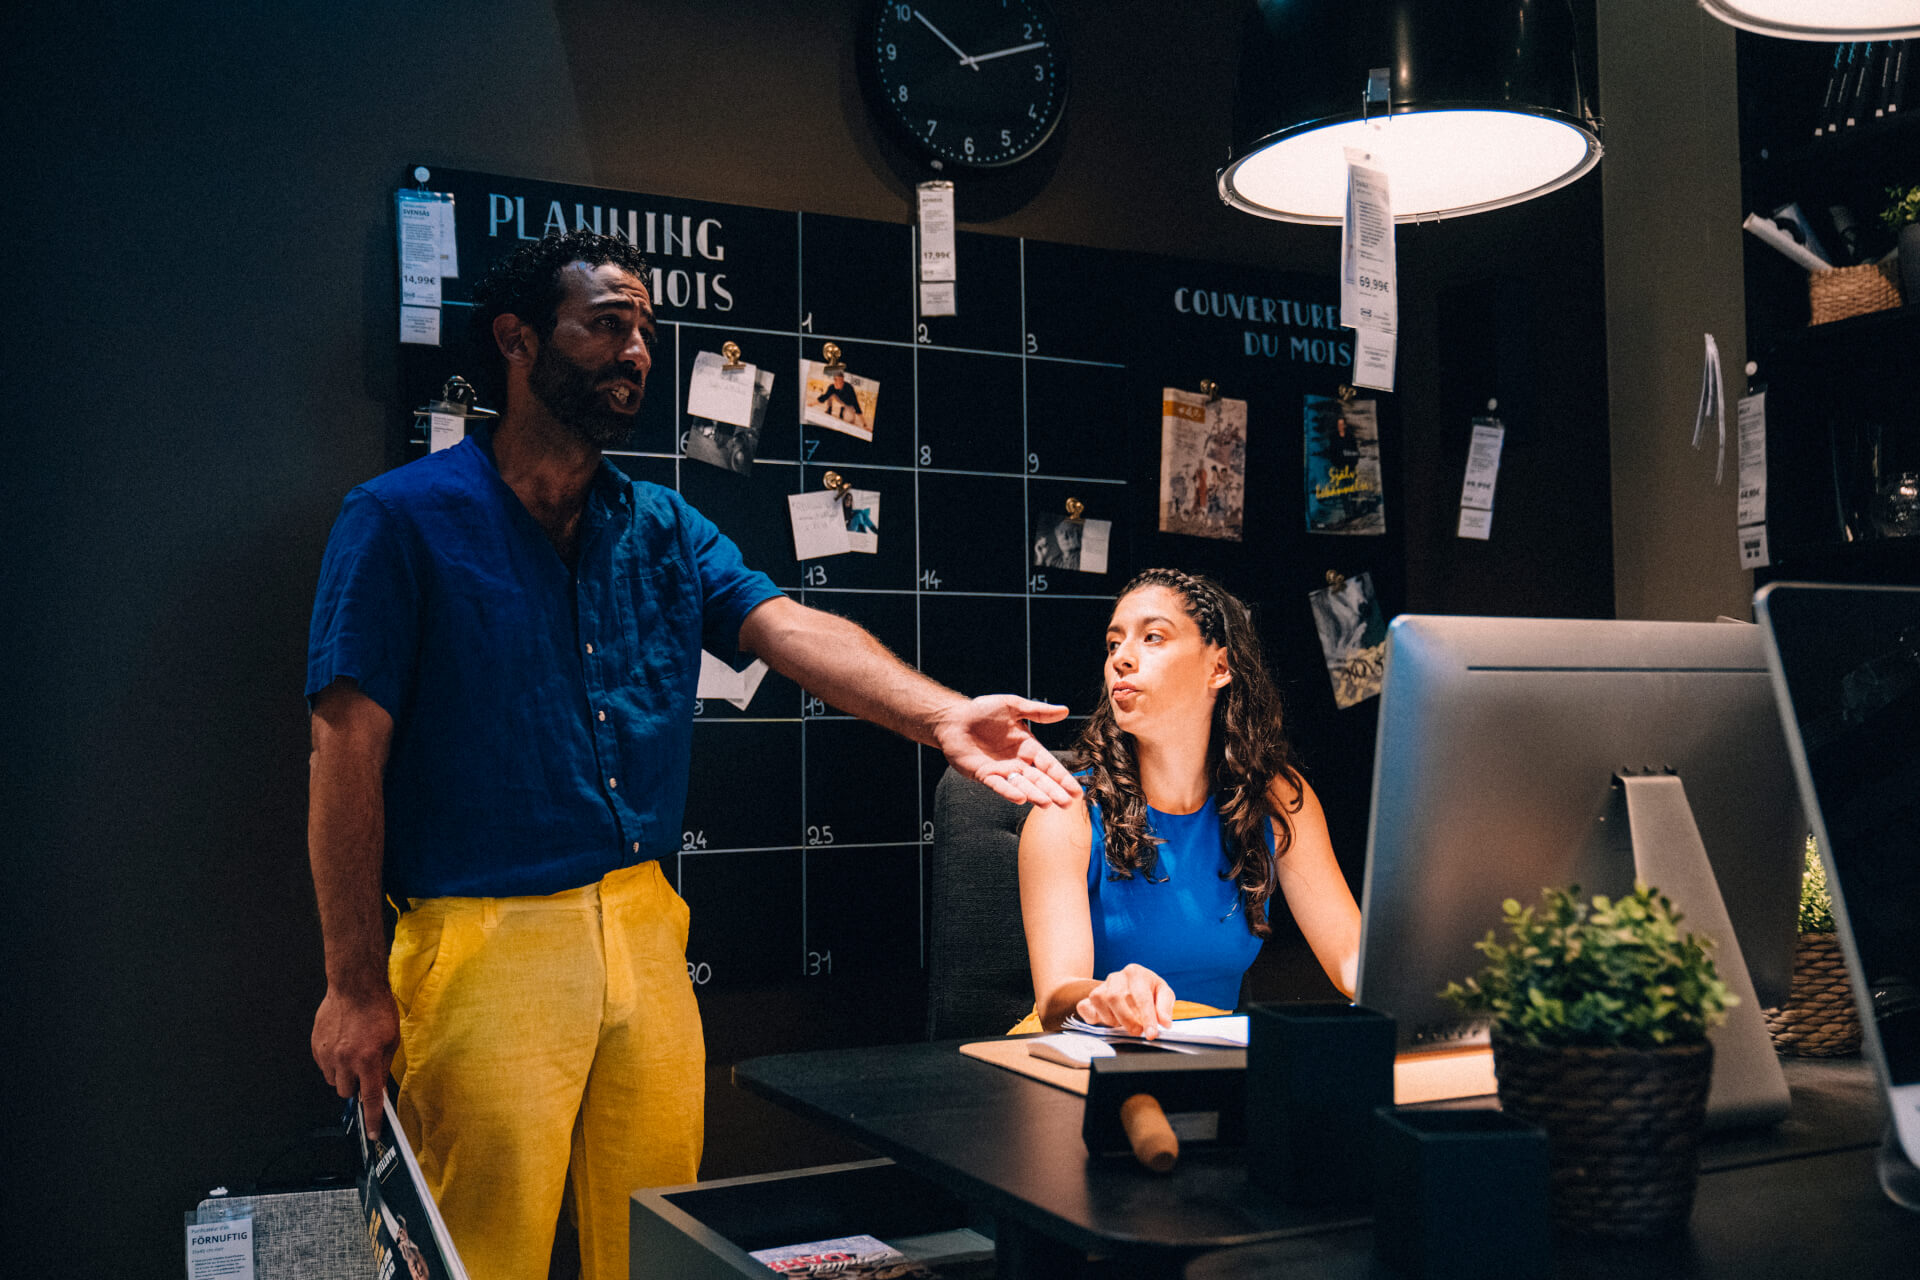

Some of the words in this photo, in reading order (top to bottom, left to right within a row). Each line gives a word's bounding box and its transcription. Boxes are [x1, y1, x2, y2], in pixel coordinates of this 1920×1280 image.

[895, 4, 911, 21] 10
[1023, 23, 1033, 40] 2
[886, 43, 897, 61] 9
[1034, 65, 1044, 81] 3
[899, 85, 908, 102] 8
[927, 120, 937, 136] 7
[964, 137, 974, 154] 6
[1001, 130, 1011, 146] 5
[488, 193, 725, 261] PLANNING
[404, 274, 436, 285] 14,99€
[1359, 275, 1390, 293] 69,99€
[1174, 287, 1350, 332] COUVERTURE
[801, 312, 812, 333] 1
[918, 324, 931, 344] 2
[1026, 334, 1038, 353] 3
[1243, 331, 1279, 358] DU
[1290, 336, 1351, 367] MOIS
[804, 440, 820, 460] 7
[920, 445, 932, 465] 8
[1028, 453, 1039, 473] 9
[805, 565, 827, 586] 13
[919, 569, 942, 590] 14
[1029, 574, 1048, 592] 15
[682, 830, 707, 850] 24
[807, 826, 834, 845] 25
[922, 821, 934, 841] 2
[808, 950, 832, 976] 31
[687, 962, 711, 984] 30
[191, 1231, 248, 1246] FÖRNUFTIG
